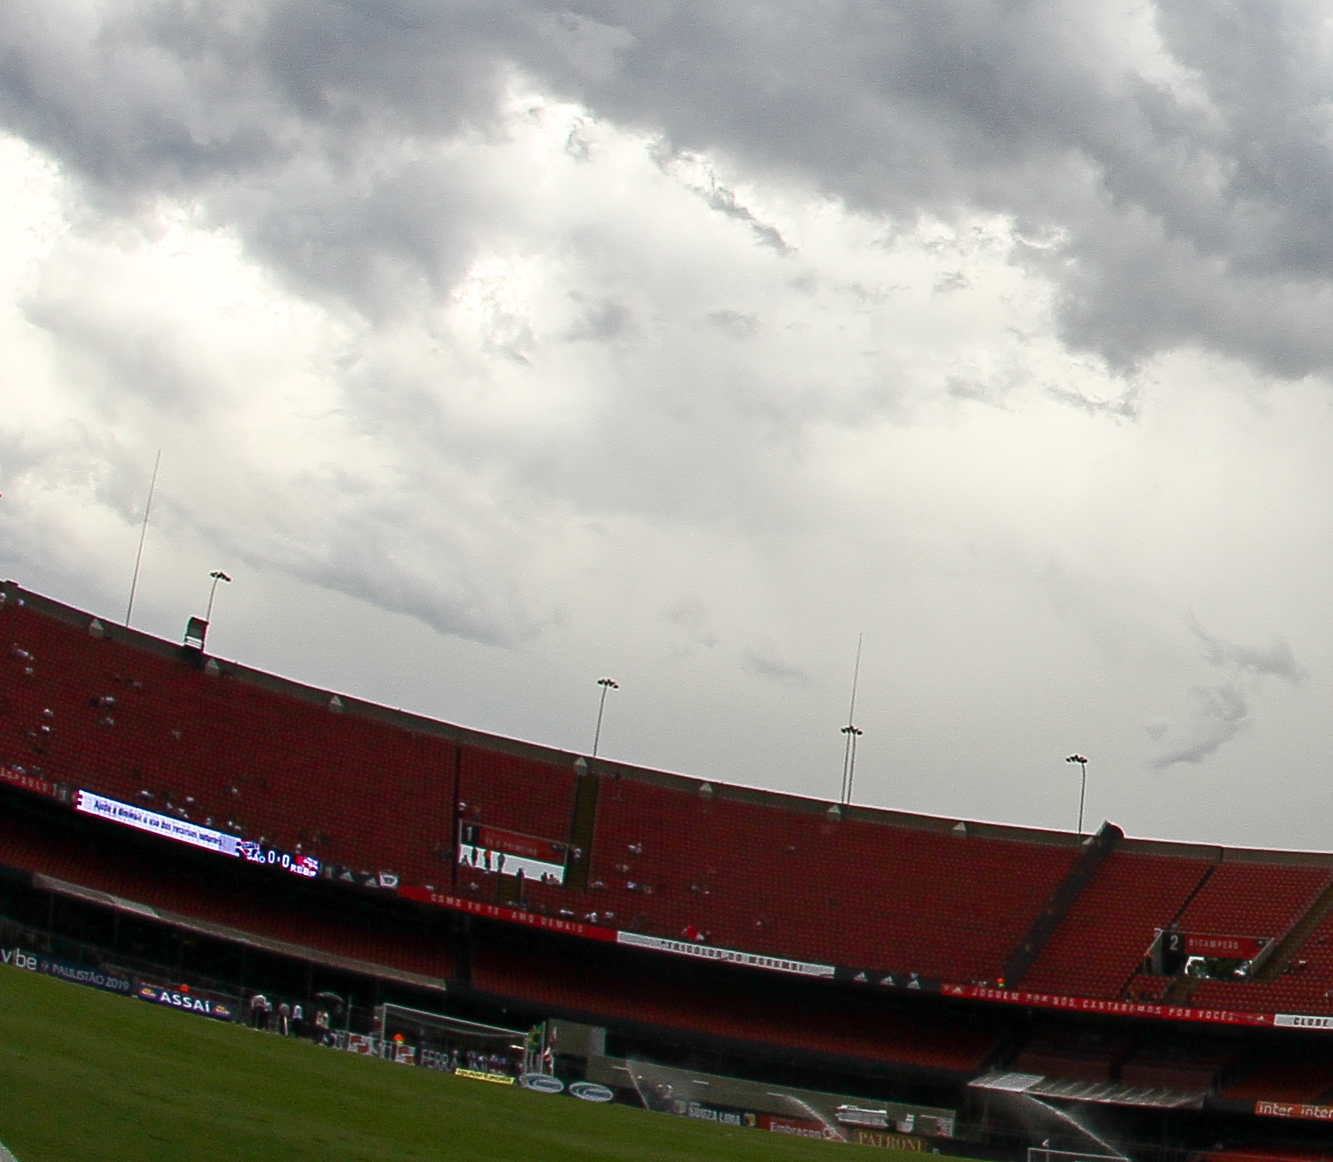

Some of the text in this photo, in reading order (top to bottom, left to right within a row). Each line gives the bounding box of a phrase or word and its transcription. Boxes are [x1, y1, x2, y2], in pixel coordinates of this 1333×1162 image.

[1170, 934, 1179, 951] 2
[106, 976, 130, 991] 2019
[1258, 1101, 1294, 1116] inter
